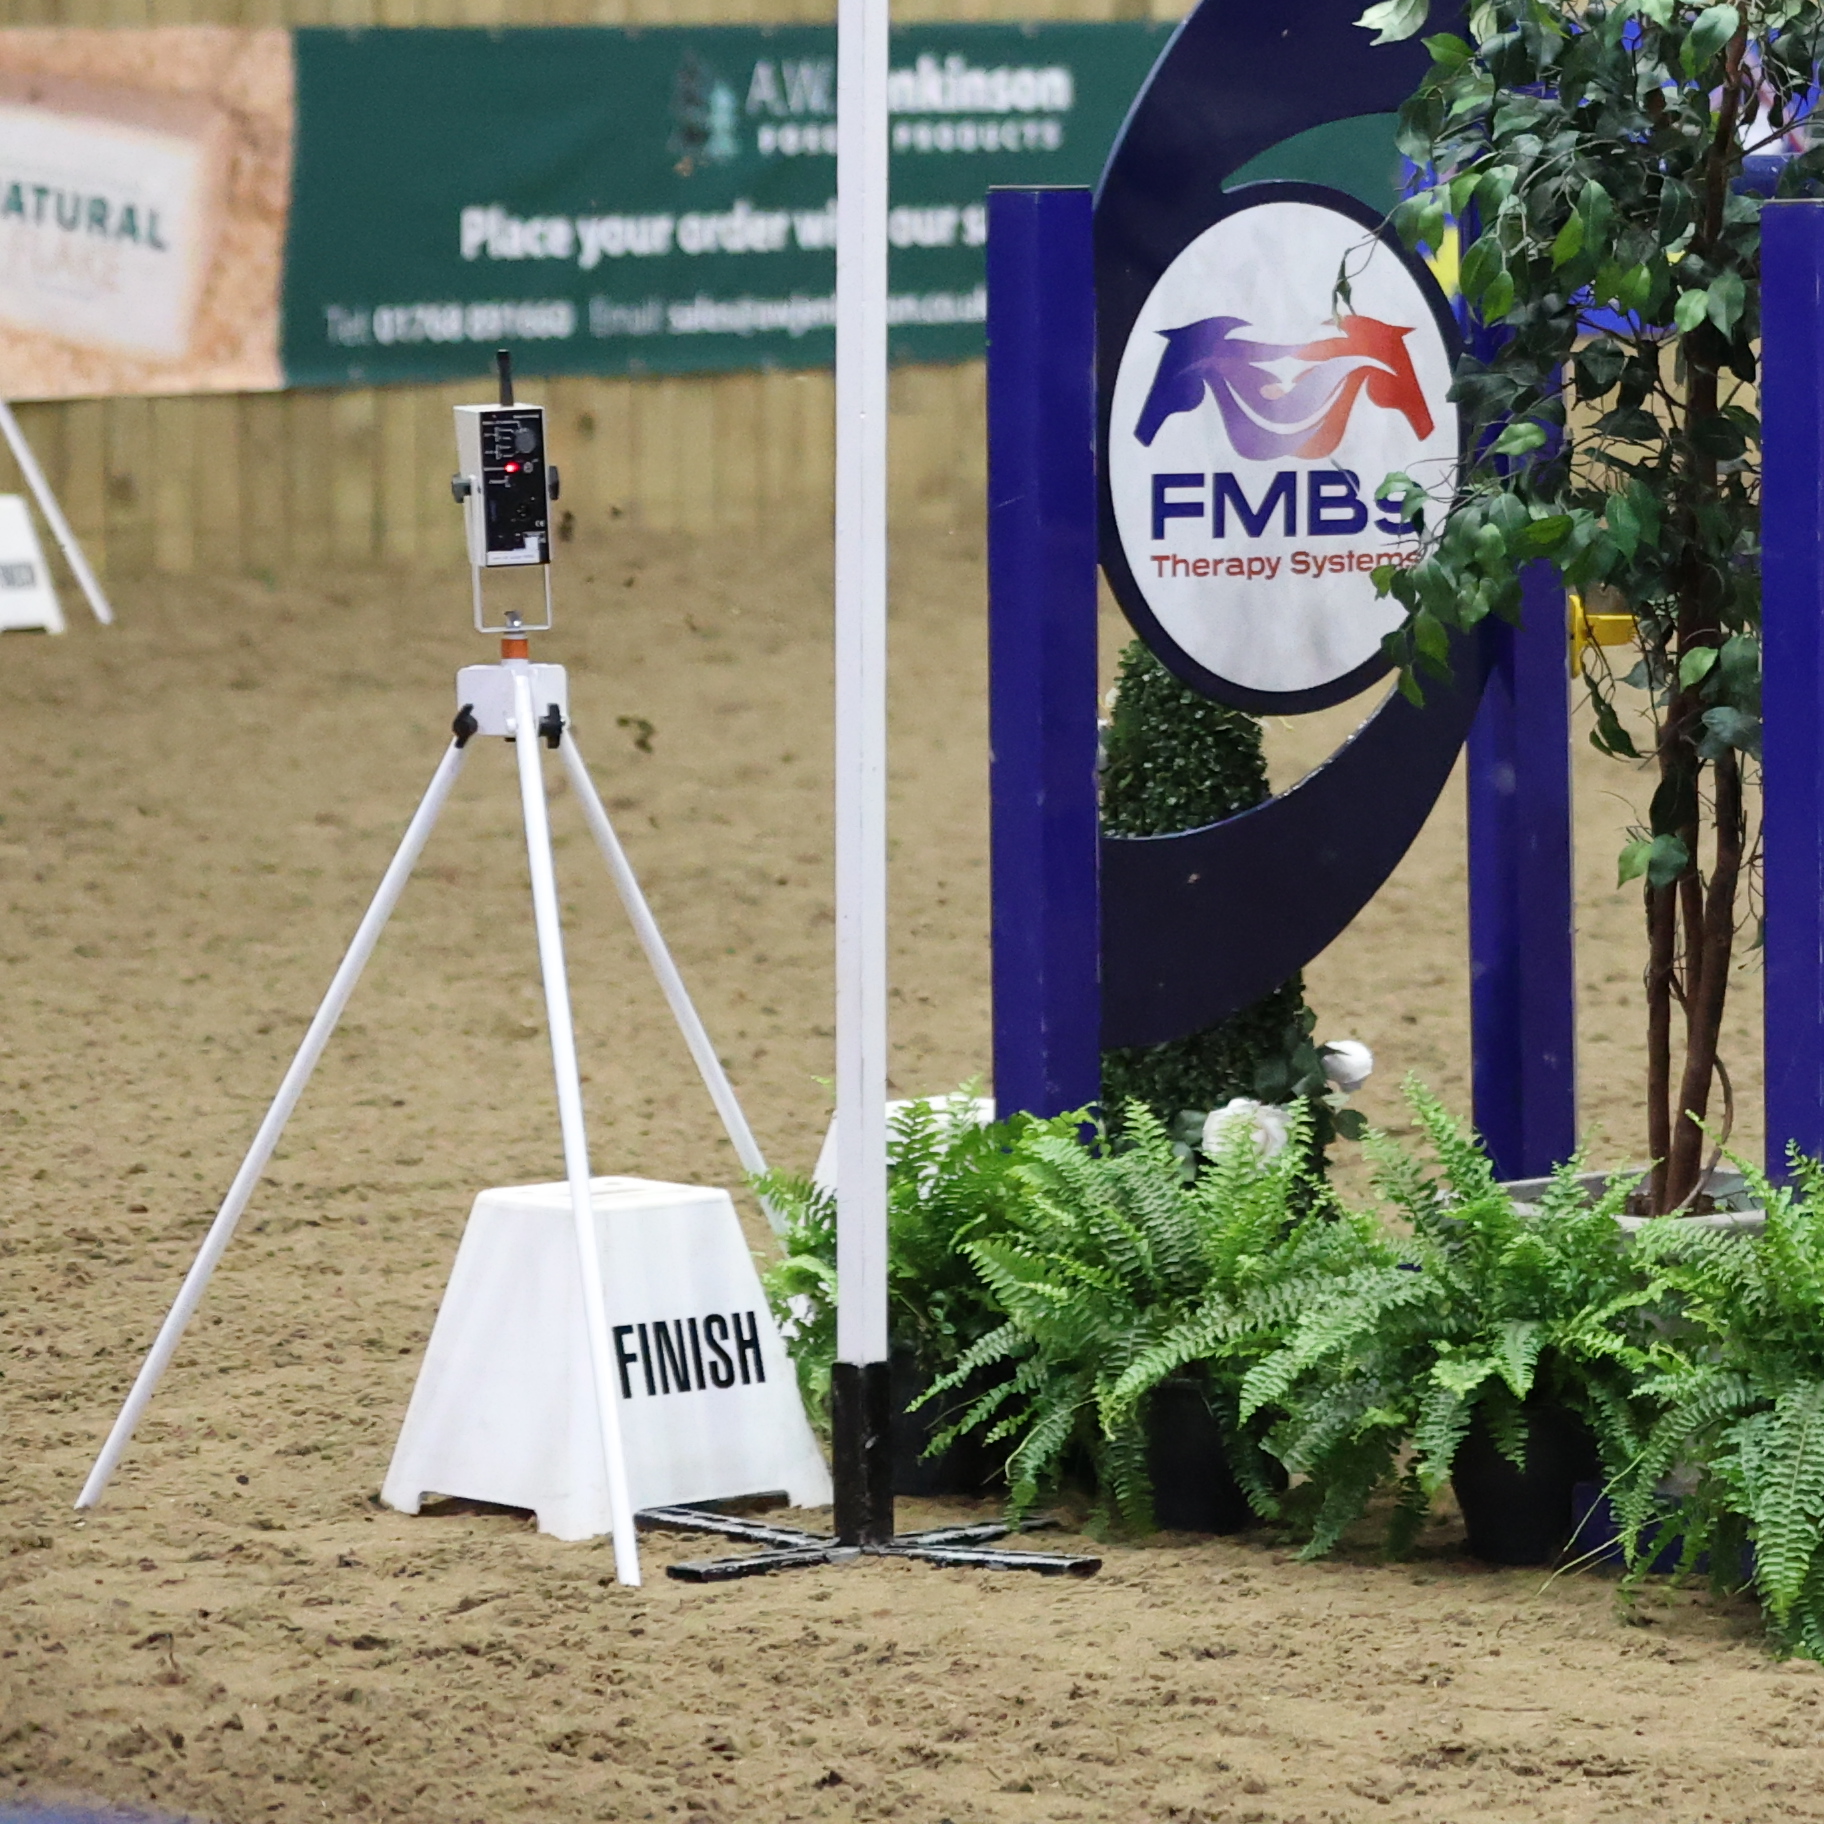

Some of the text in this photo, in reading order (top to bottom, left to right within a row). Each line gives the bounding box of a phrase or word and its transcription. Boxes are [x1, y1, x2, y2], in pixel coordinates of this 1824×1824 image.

[459, 204, 575, 261] Place
[575, 215, 674, 270] your
[675, 199, 792, 255] order
[1151, 553, 1281, 580] Therapy
[612, 1310, 766, 1399] FINISH
